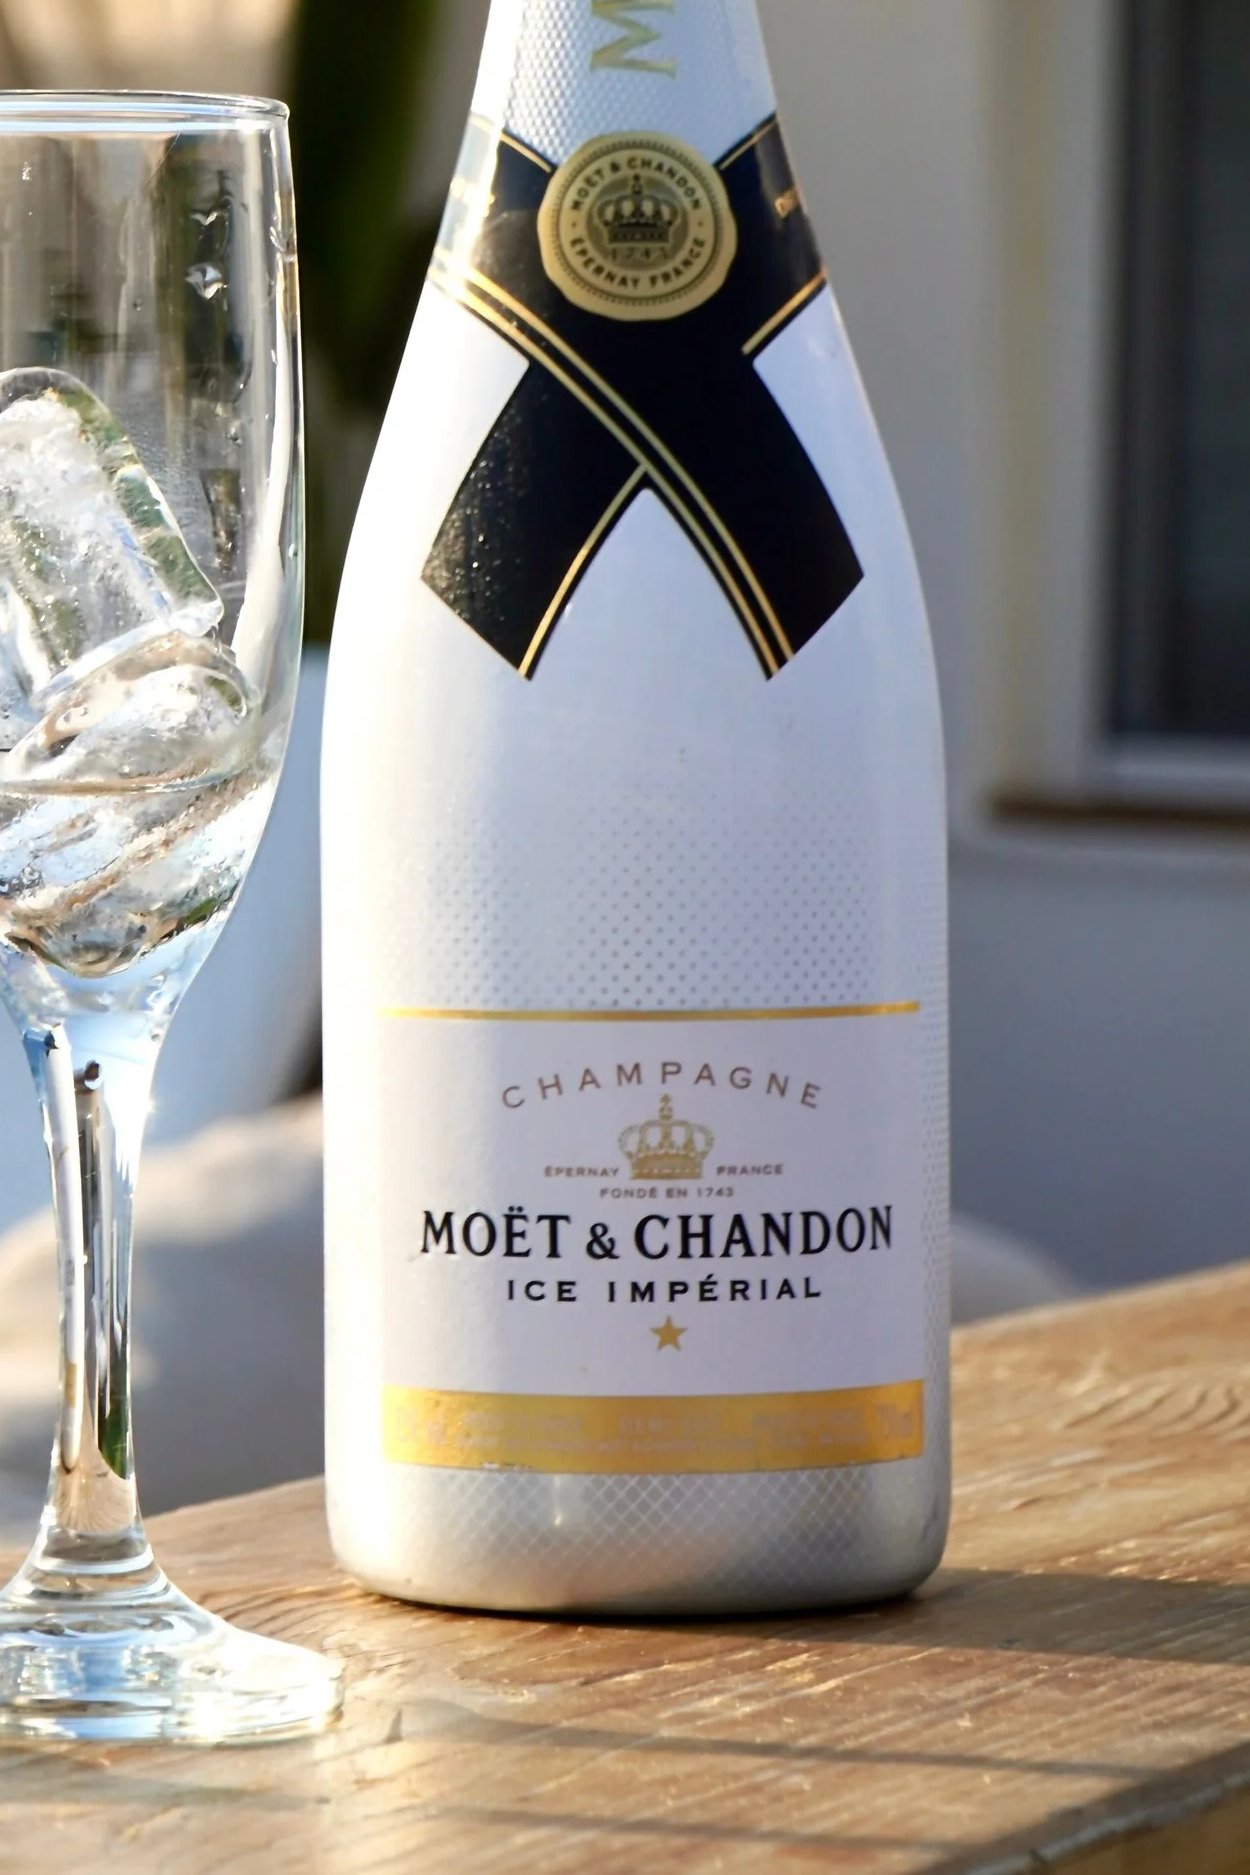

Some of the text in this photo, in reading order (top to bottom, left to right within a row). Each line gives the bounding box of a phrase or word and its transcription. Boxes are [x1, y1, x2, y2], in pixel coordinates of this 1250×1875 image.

[626, 156, 701, 210] CHANDON
[649, 236, 706, 289] FRANCE
[502, 1060, 822, 1110] CHAMPAGNE
[600, 1185, 735, 1199] FONDÉ EN 1743
[716, 1163, 783, 1176] FRANCE
[420, 1205, 893, 1259] MOËT & CHANDON
[507, 1273, 822, 1303] ICE IMPÉRIAL
